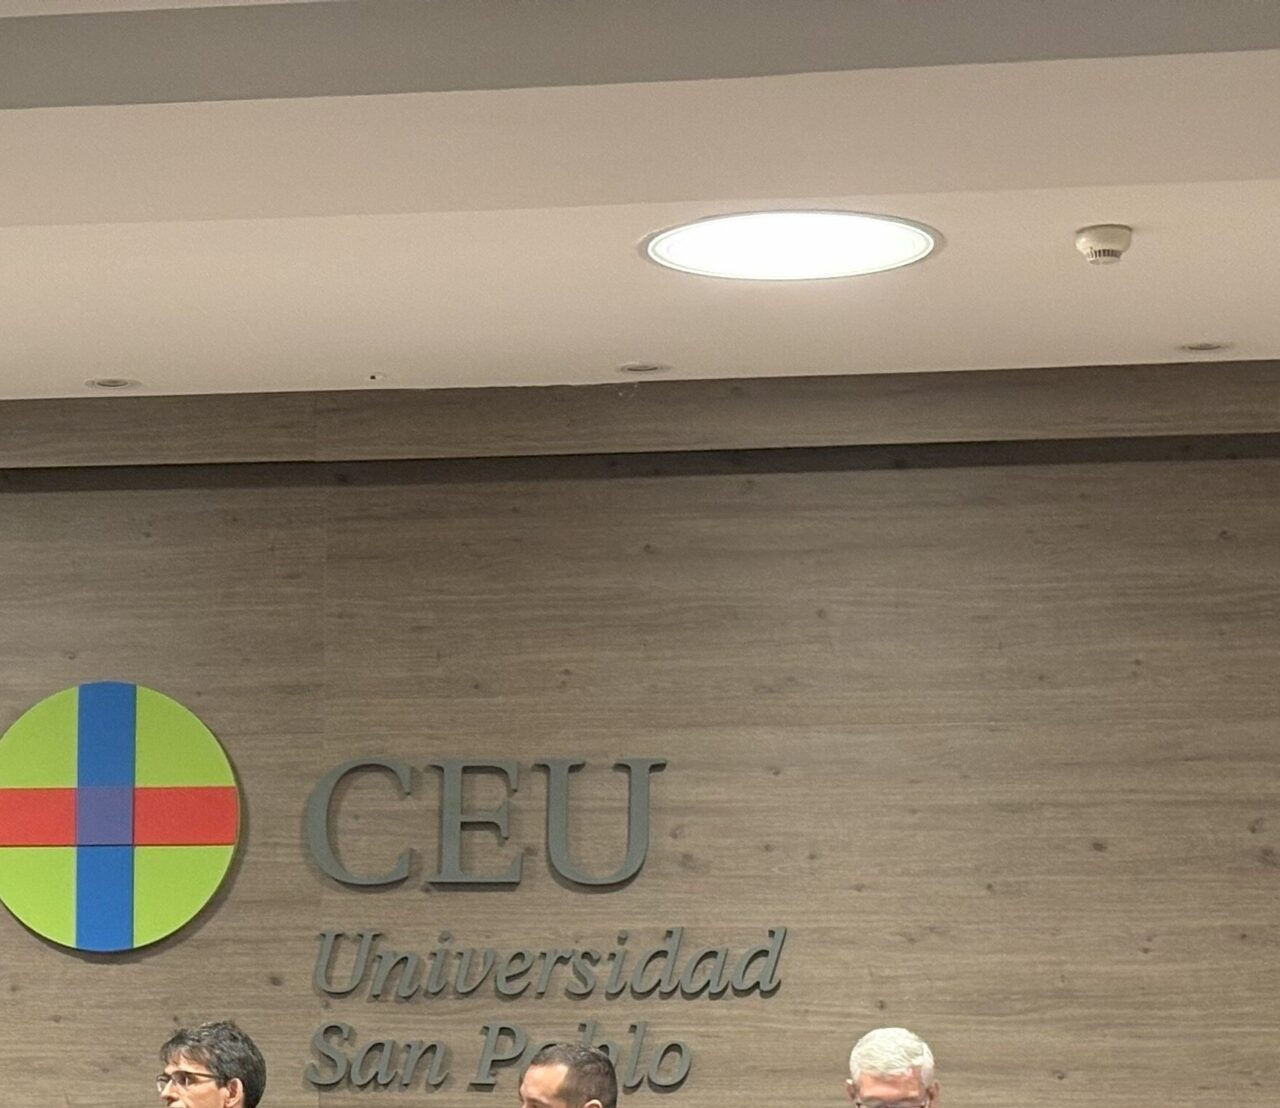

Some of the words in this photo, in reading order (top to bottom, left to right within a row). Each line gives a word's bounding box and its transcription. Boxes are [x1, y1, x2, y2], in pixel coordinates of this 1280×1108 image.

[305, 758, 668, 888] CEU
[314, 926, 788, 998] Universidad
[307, 1022, 450, 1088] San
